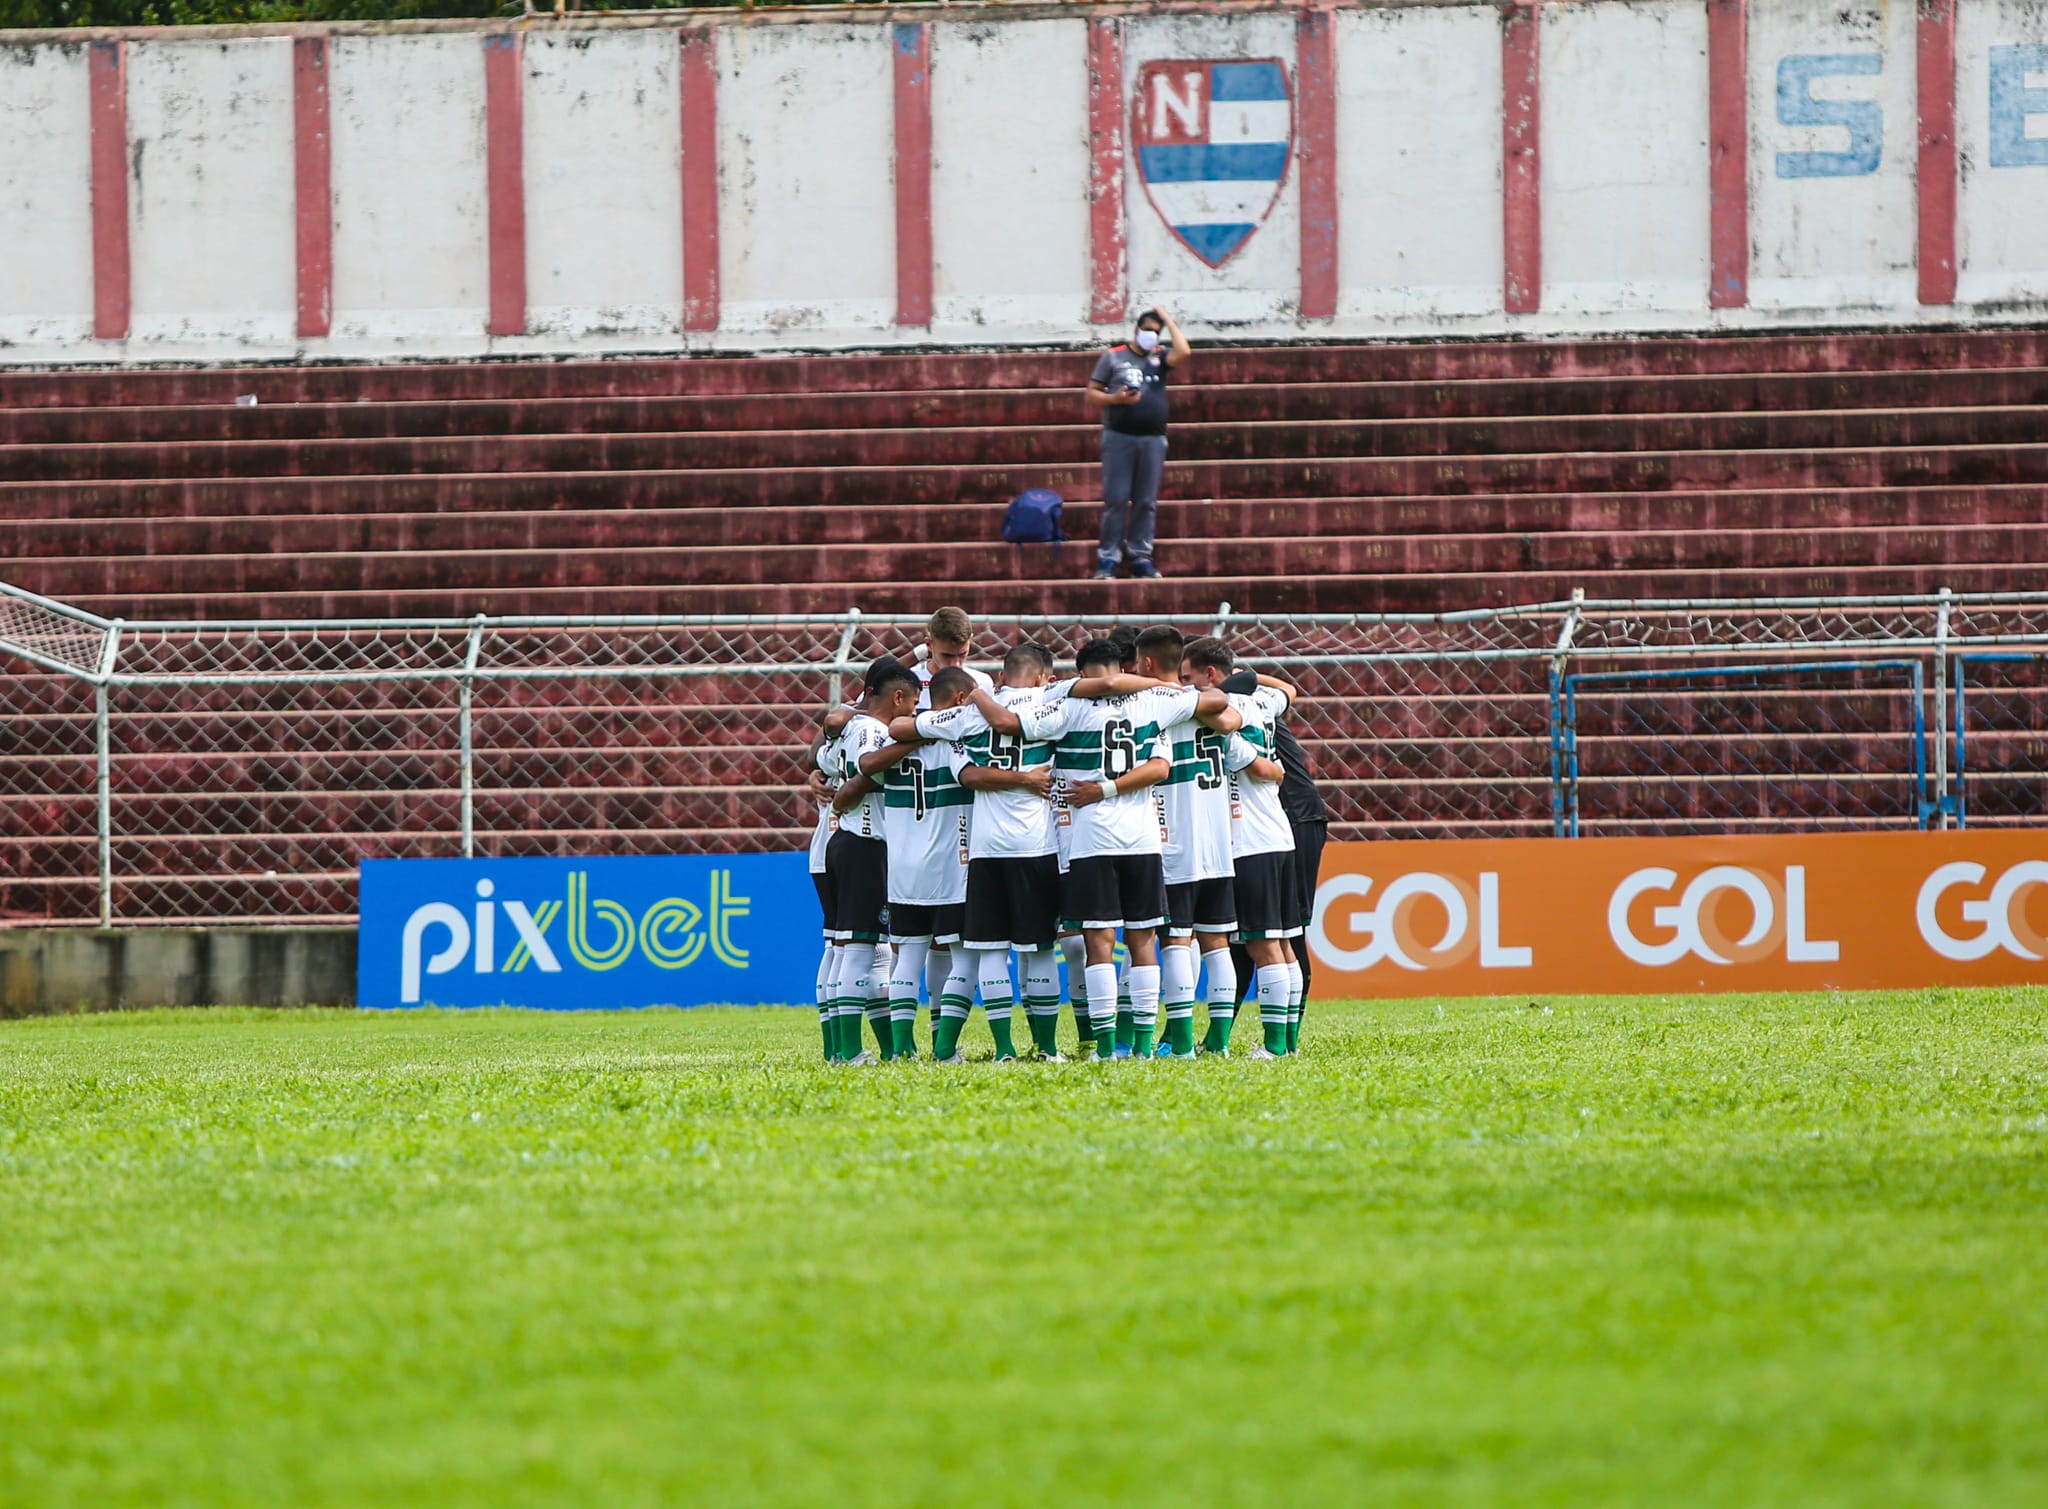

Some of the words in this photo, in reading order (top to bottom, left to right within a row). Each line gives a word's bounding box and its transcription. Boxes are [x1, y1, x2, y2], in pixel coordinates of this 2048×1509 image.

[1152, 73, 1202, 137] N
[1777, 53, 1882, 178] S
[1103, 717, 1136, 780] 6
[1195, 727, 1224, 790] 5
[900, 757, 926, 822] 7
[401, 870, 751, 1002] pixbet
[1308, 872, 1532, 970] GOL
[1608, 865, 1839, 966] GOL
